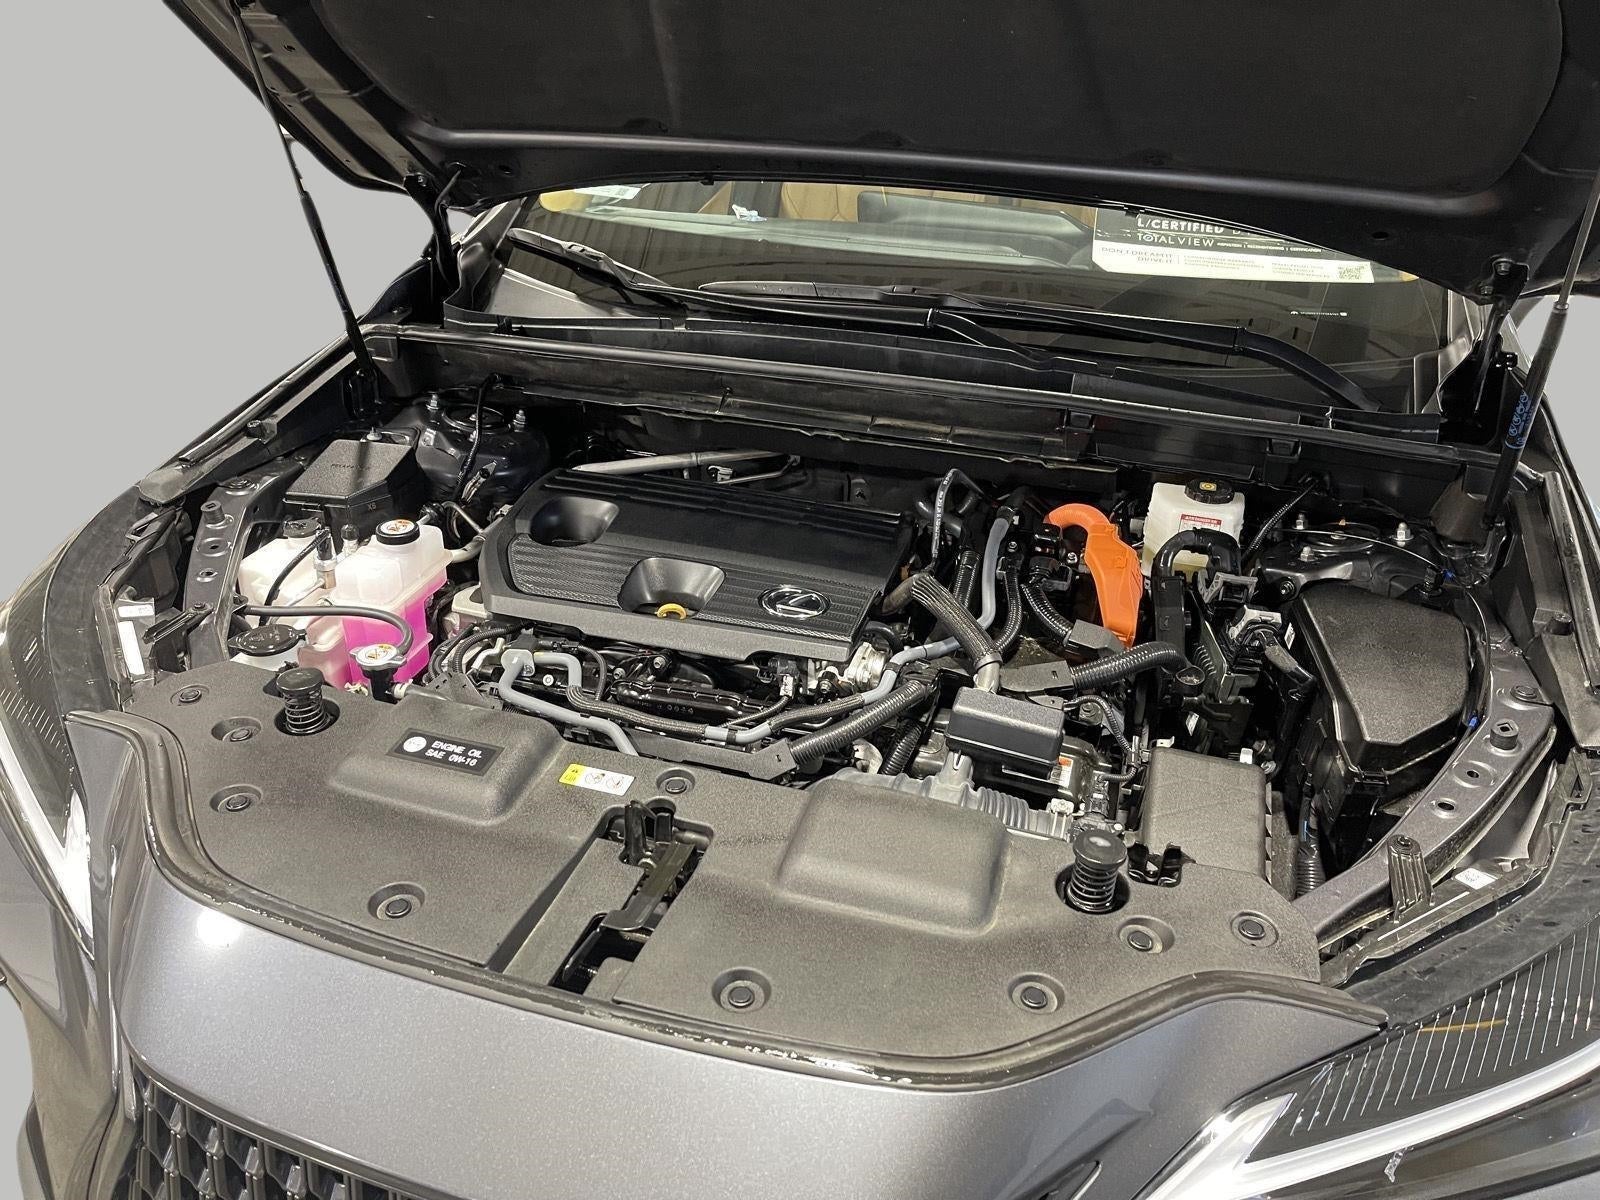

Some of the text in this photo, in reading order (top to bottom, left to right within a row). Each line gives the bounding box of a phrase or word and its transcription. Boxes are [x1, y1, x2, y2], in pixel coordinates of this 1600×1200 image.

[1137, 233, 1214, 247] TOTAL VIEW
[425, 749, 446, 759] SAE
[431, 740, 466, 754] ENGINE
[467, 749, 482, 758] OIL
